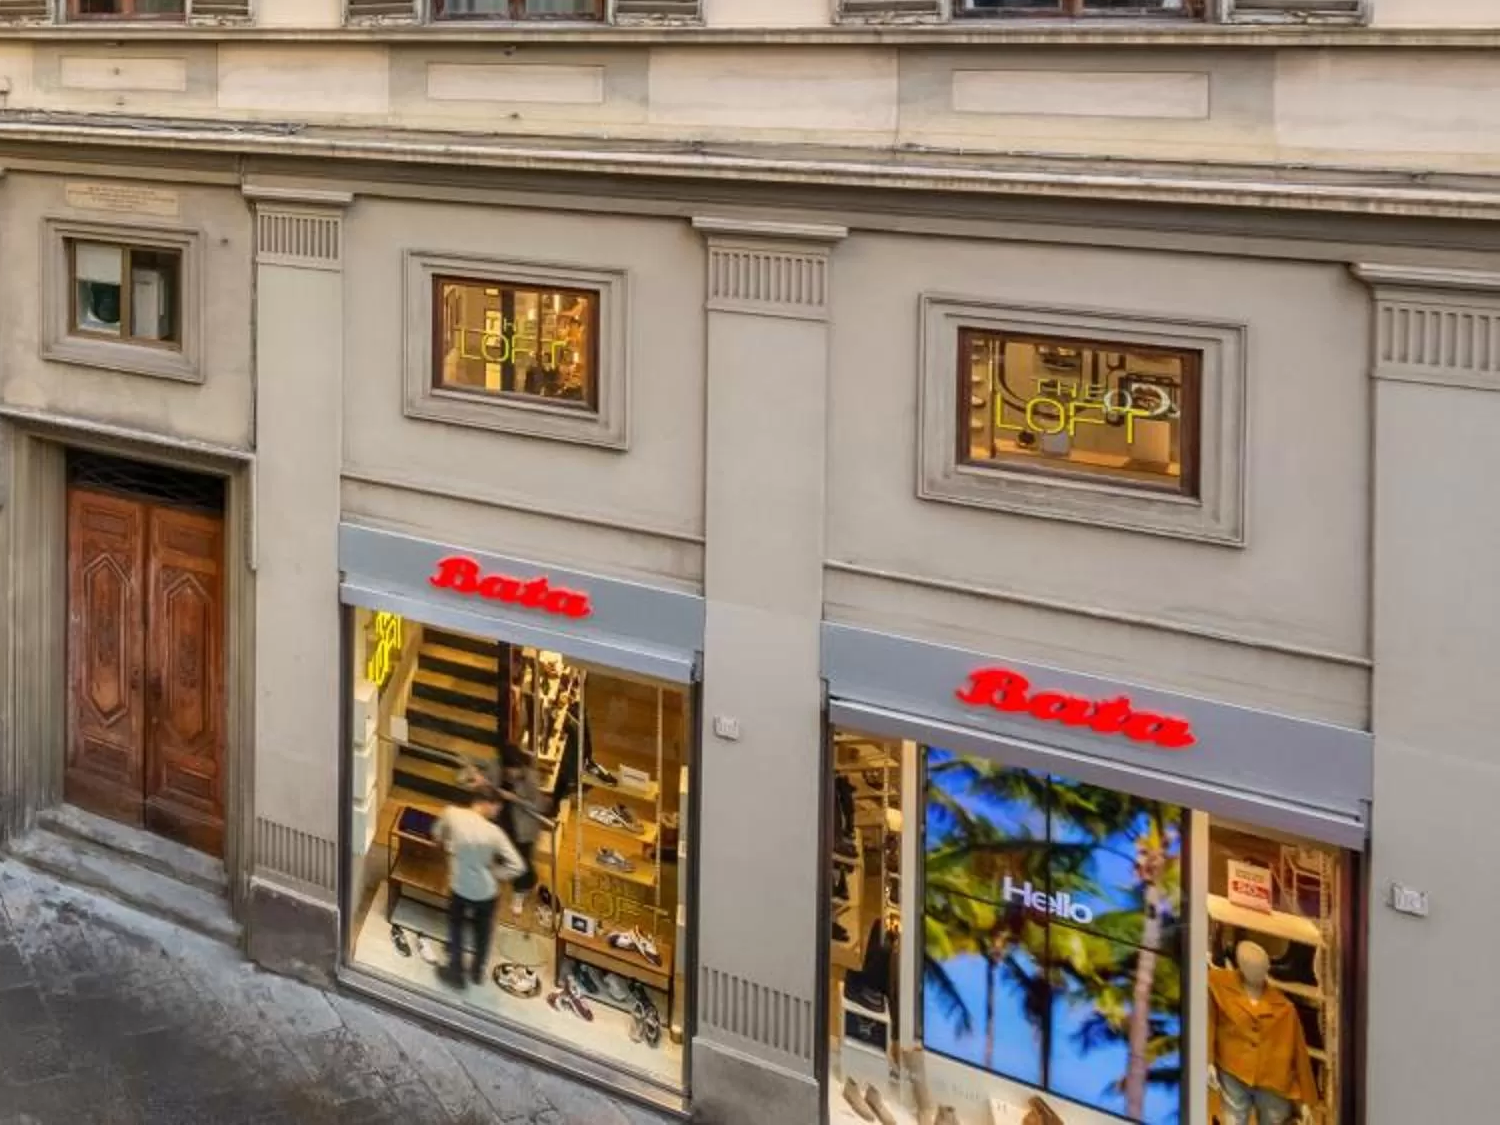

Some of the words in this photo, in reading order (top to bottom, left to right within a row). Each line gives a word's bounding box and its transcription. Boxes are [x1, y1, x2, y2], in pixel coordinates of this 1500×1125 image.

[995, 391, 1150, 444] LOFT
[427, 555, 594, 619] Bata
[956, 667, 1197, 748] Bata
[1003, 876, 1093, 924] Hello
